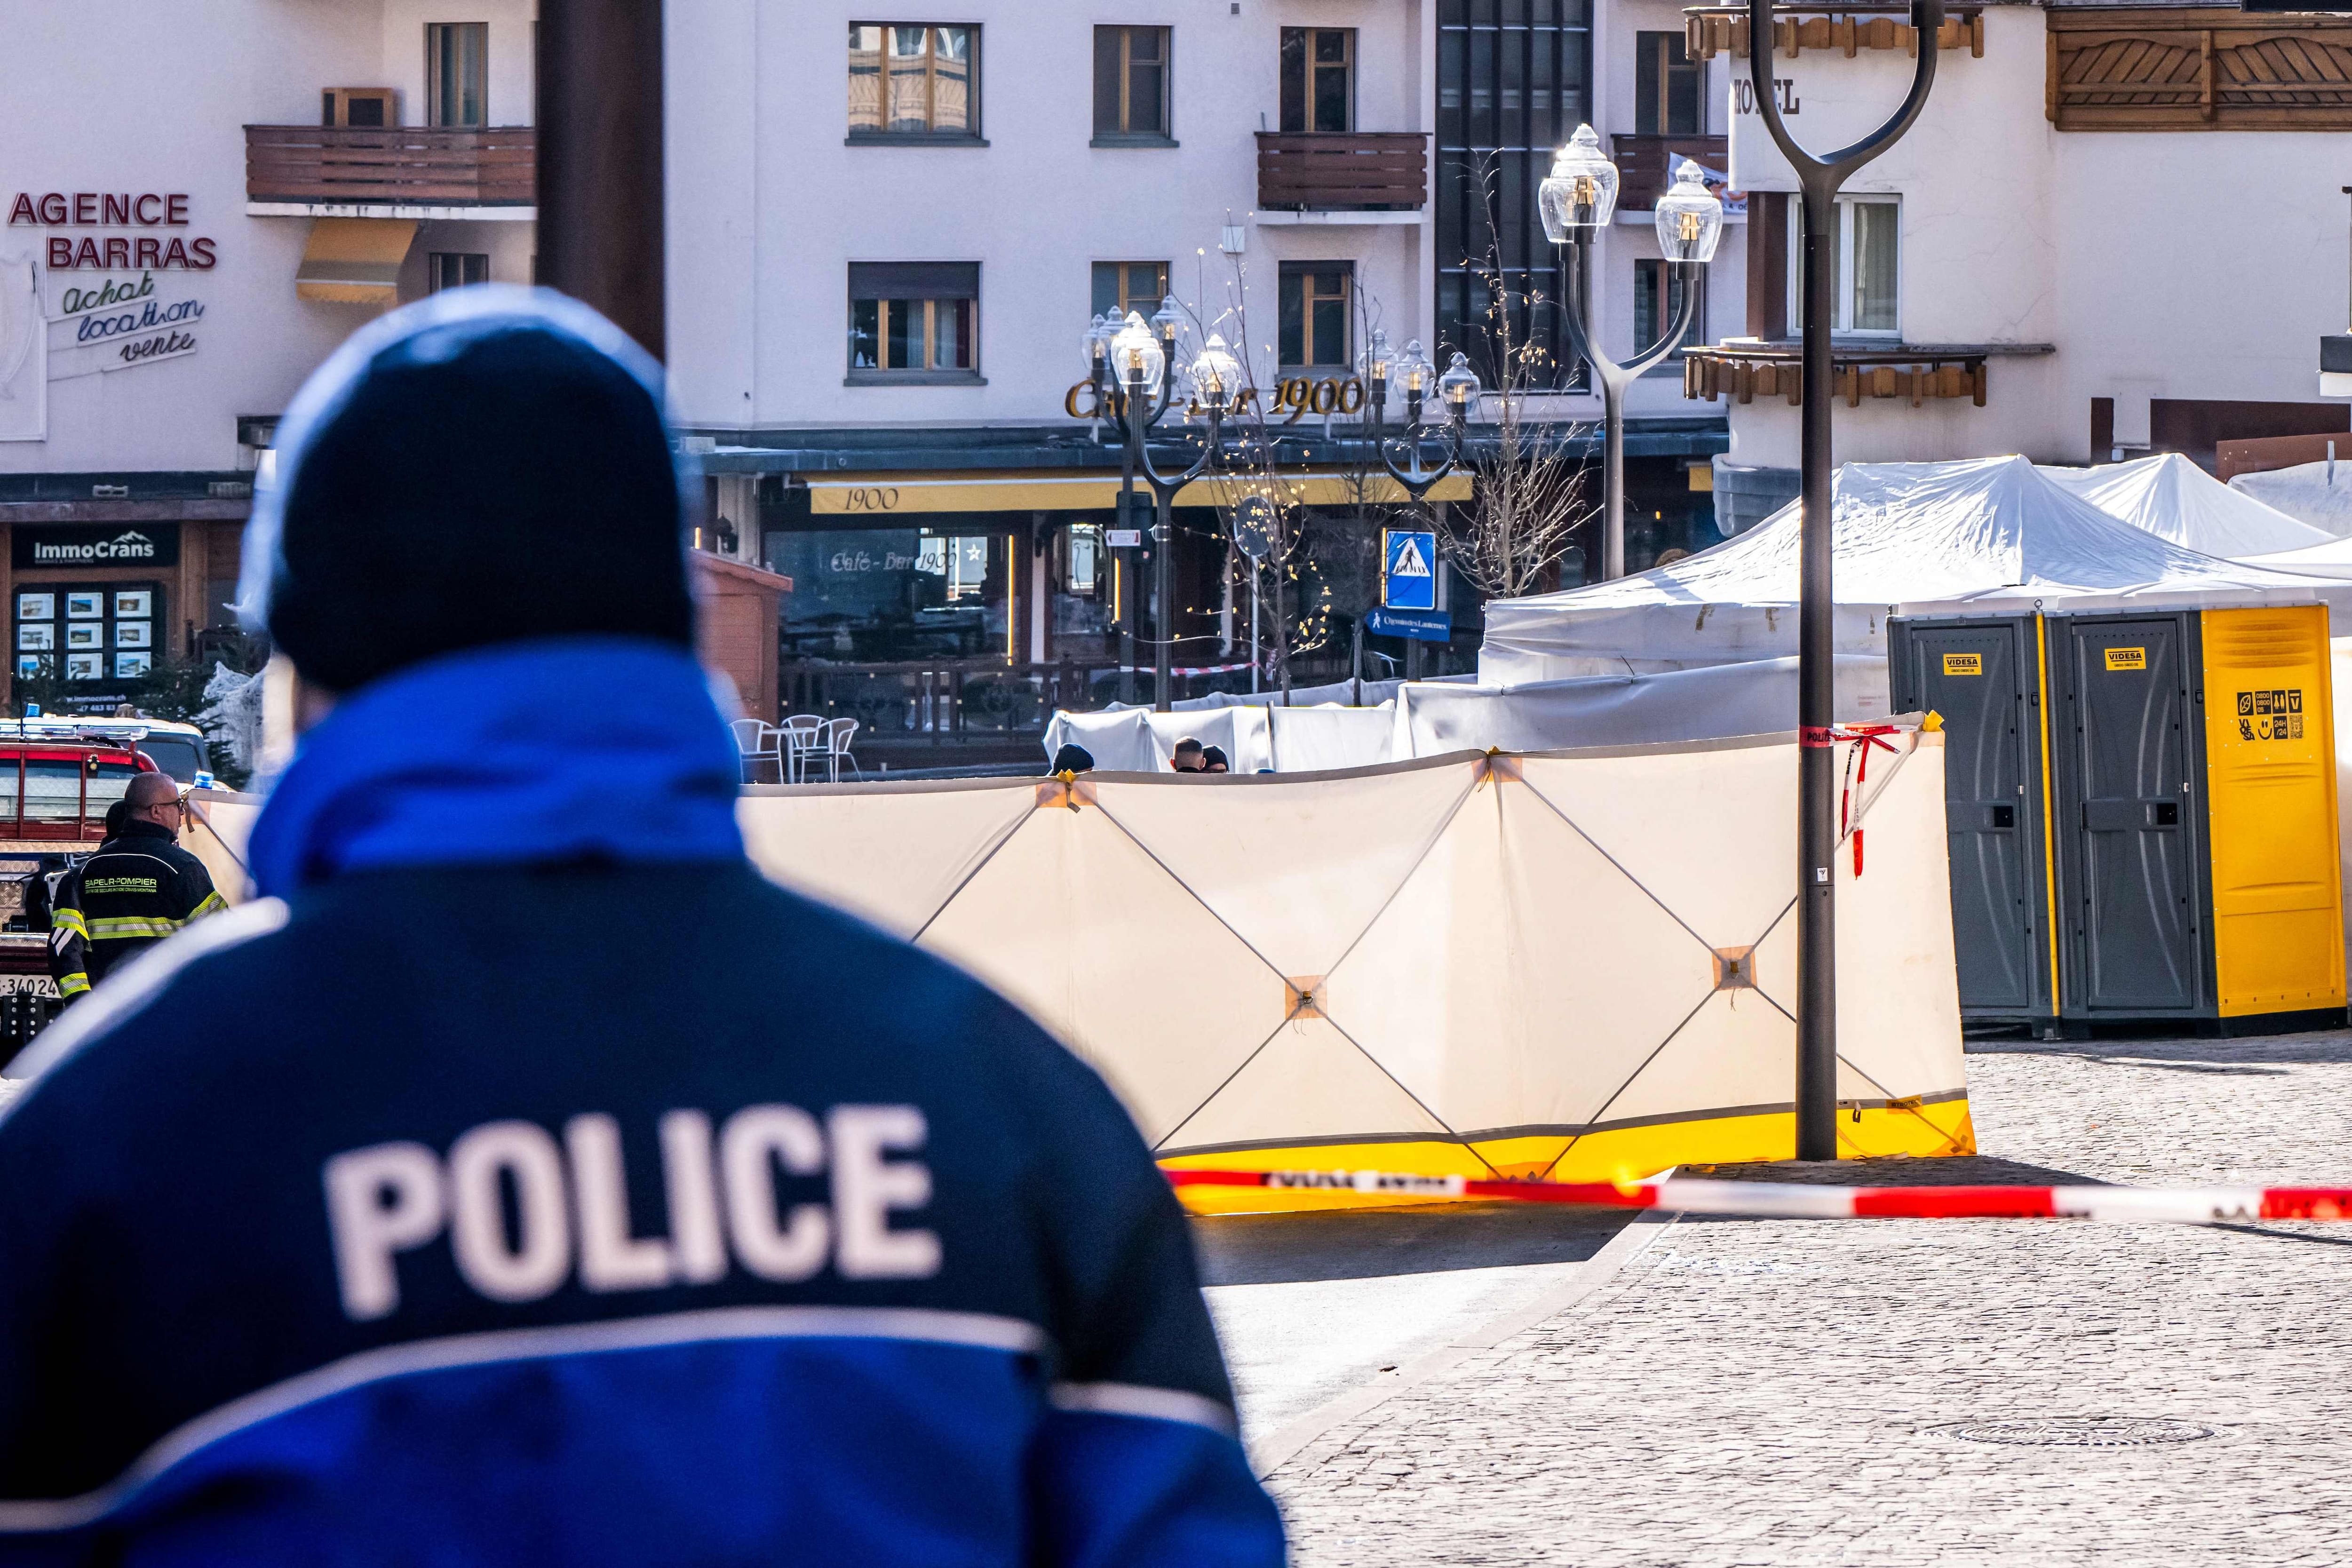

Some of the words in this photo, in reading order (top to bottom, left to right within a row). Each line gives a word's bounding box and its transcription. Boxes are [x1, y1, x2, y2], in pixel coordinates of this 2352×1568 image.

[1734, 79, 1799, 114] HOL
[8, 192, 189, 225] AGENCE
[47, 237, 217, 269] BARRAS
[63, 271, 154, 314] achat
[78, 300, 205, 342] location
[119, 330, 196, 361] vente
[1267, 376, 1365, 425] 1900
[844, 488, 898, 511] 1900
[34, 541, 154, 558] ImmoCrans
[830, 551, 870, 572] Café
[883, 552, 914, 570] Bar
[919, 552, 957, 571] 1900
[85, 877, 157, 887] SAPEUR-POMPIER
[322, 1104, 941, 1320] POLICE
